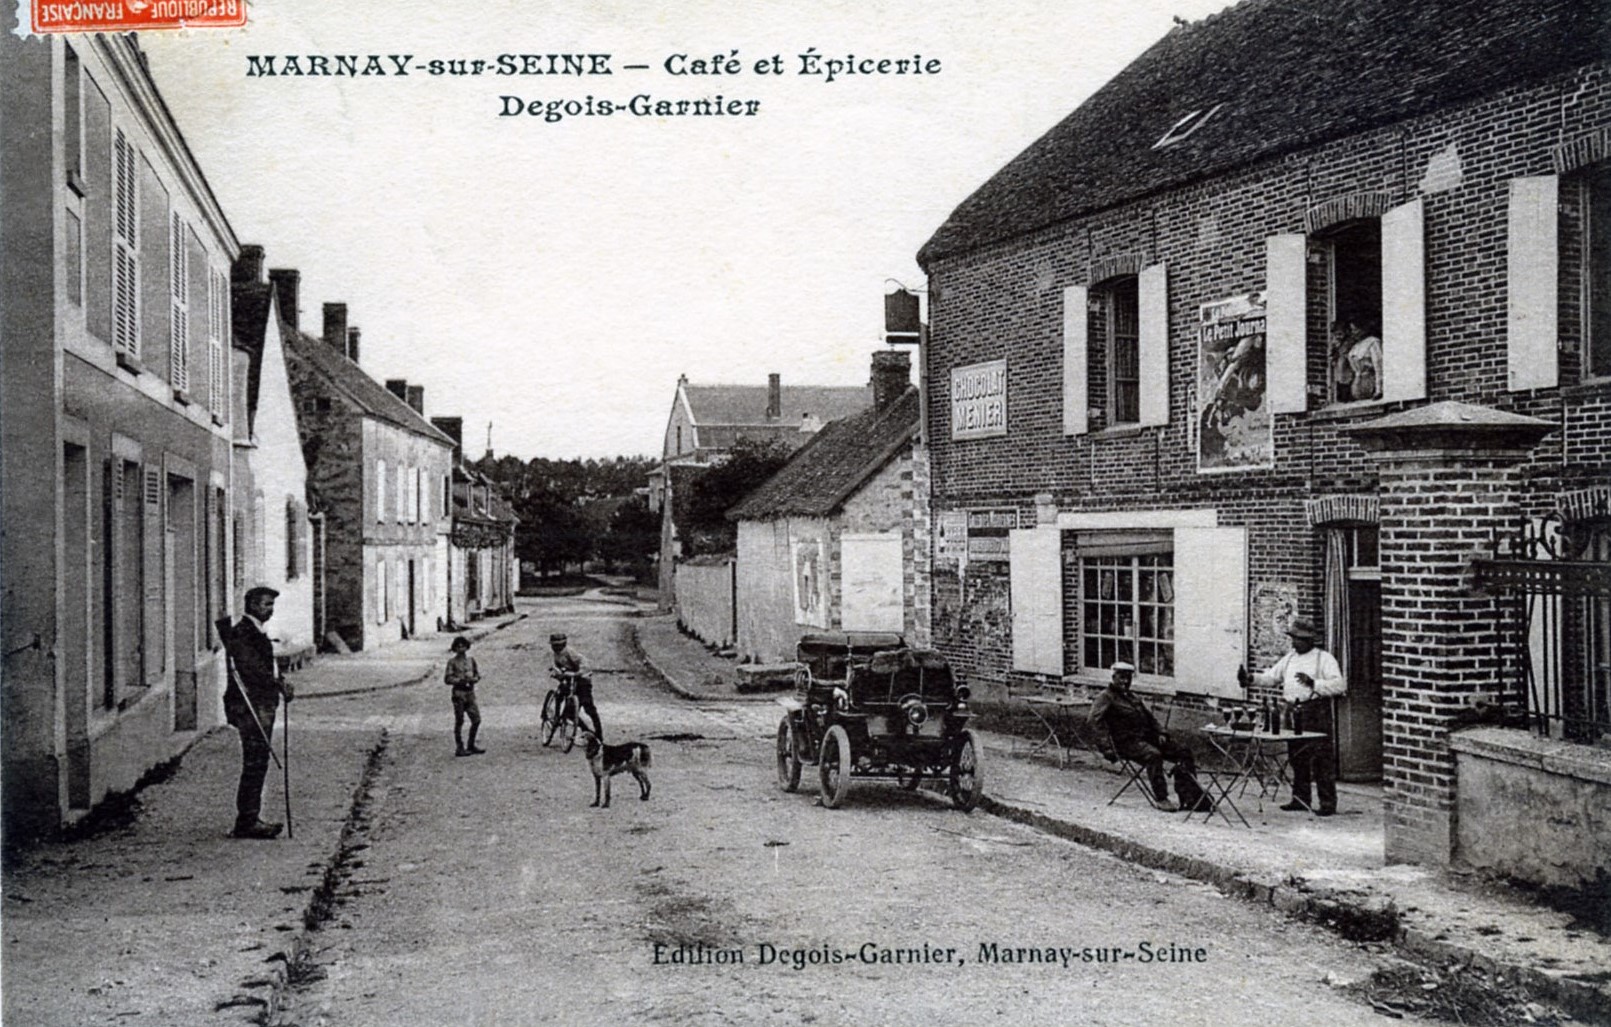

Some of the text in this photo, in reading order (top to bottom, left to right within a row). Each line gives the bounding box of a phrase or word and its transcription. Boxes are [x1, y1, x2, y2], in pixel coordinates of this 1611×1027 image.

[42, 2, 124, 22] FRANÇAISE
[1202, 318, 1266, 342] Le Petit Journa
[954, 370, 1004, 402] CHOCOLAT
[956, 401, 1003, 432] MENIER
